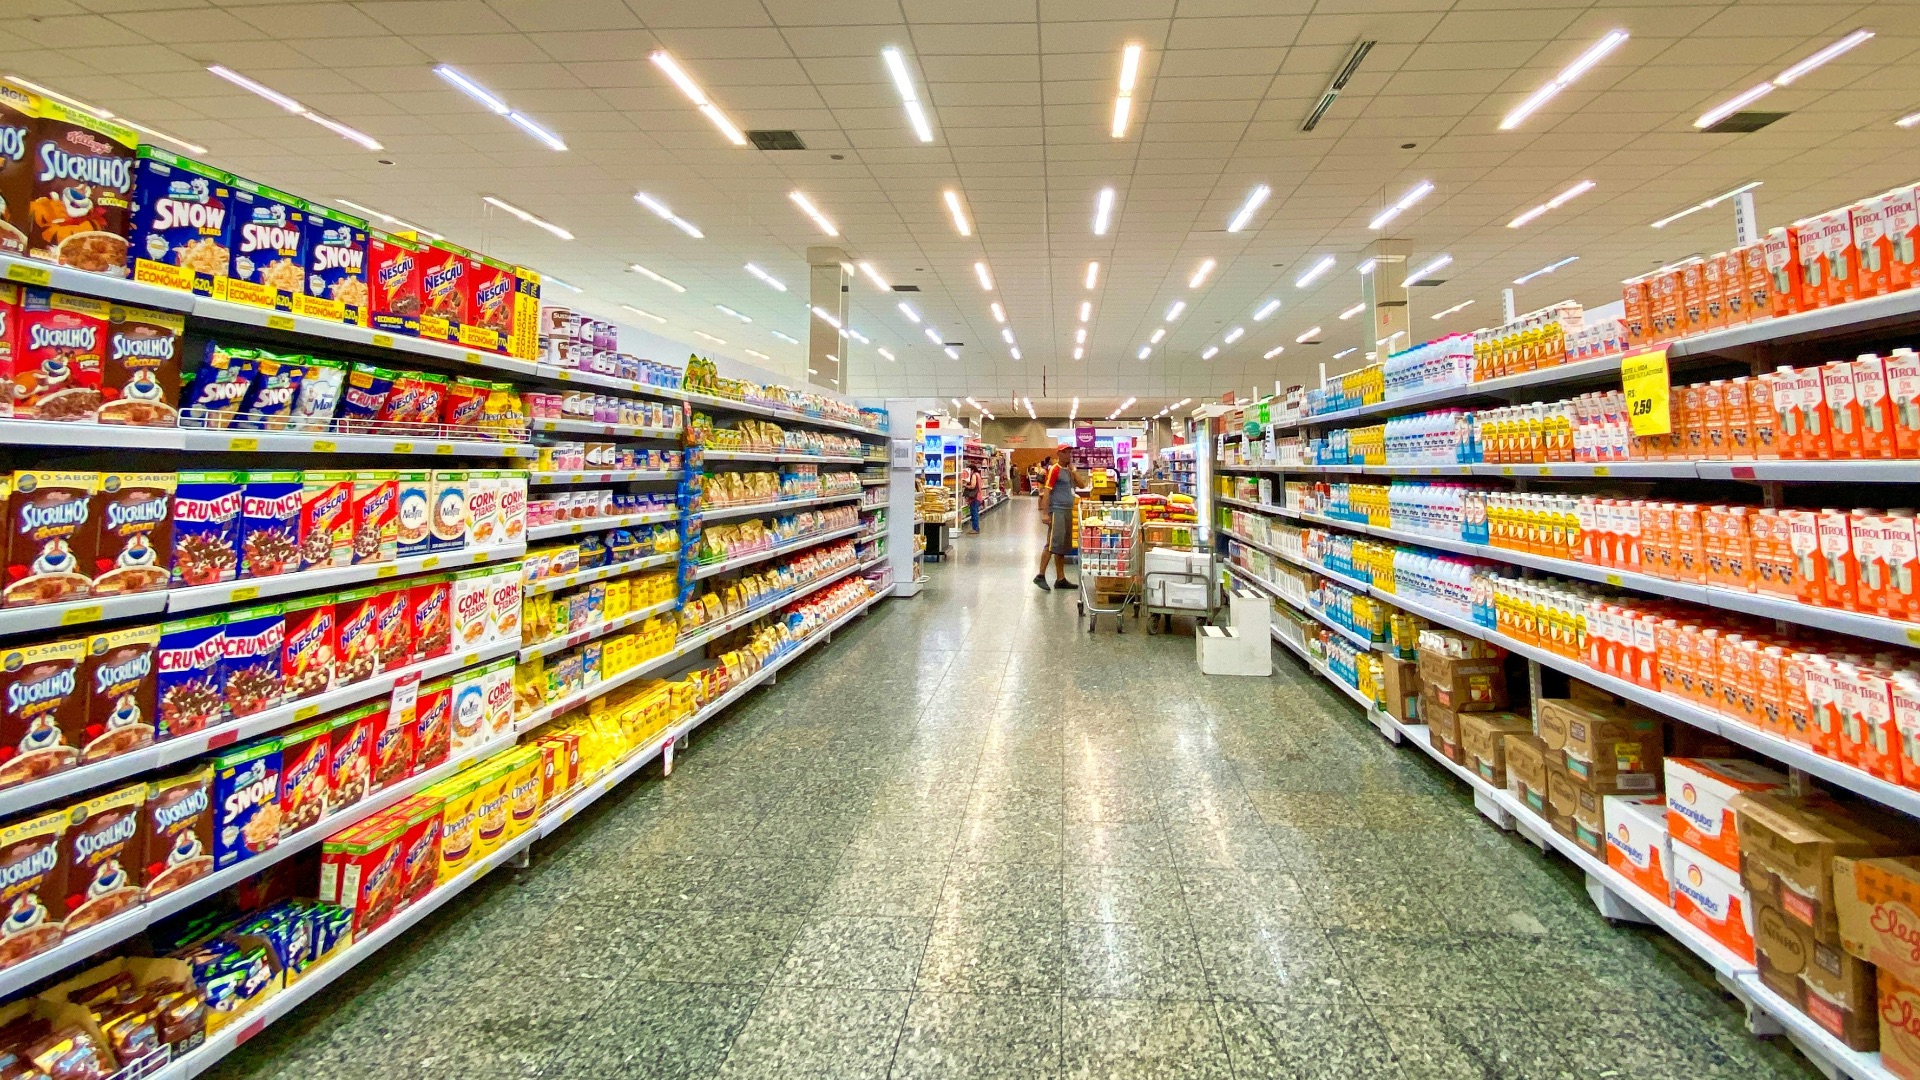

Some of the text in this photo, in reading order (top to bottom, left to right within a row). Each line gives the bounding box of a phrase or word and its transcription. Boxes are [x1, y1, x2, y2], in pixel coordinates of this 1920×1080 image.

[40, 143, 131, 194] SUCRILHOS
[153, 199, 225, 230] SNOW
[1854, 212, 1882, 227] TIROL
[1884, 202, 1915, 218] TIROL
[240, 224, 300, 252] SNOW
[1799, 231, 1822, 245] TIROL
[1823, 224, 1848, 237] TIROL
[314, 245, 364, 271] SNOW
[1765, 240, 1787, 254] TIROL
[138, 260, 180, 275] EMBALAGEM
[379, 258, 414, 284] NESCAU
[425, 262, 463, 293] NESCAU
[137, 269, 192, 291] ECONÔMICA
[477, 280, 511, 306] NESCAU
[420, 317, 441, 325] BALAGEM
[420, 322, 447, 337] CONÔMICA
[30, 324, 97, 350] SUCRILHOS
[113, 334, 175, 360] SUCRILHOS
[1796, 379, 1819, 389] TIROL
[1825, 375, 1852, 386] TIROL
[1854, 372, 1882, 383] TIROL
[1888, 367, 1919, 379] TIROL
[1773, 381, 1796, 391] TIROL
[348, 389, 387, 410] CRUNC
[174, 494, 240, 520] CRUNCH
[244, 492, 302, 516] CRUNCH
[312, 490, 347, 521] NESCAU
[363, 488, 394, 519] NESCAU
[469, 491, 495, 511] CORN
[501, 490, 523, 509] CORN
[21, 497, 90, 533] SUCRILHOS
[107, 496, 168, 530] SUCRILHOS
[1791, 523, 1814, 535] TIROL
[1820, 525, 1846, 536] TIROL
[1852, 527, 1880, 539] TIROL
[1881, 528, 1913, 541] TIROL
[458, 589, 485, 613] CORN
[493, 582, 517, 606] CORN
[415, 589, 446, 625] NESCAU
[124, 628, 159, 639] SABOR
[288, 615, 332, 661] NESCAU
[341, 605, 376, 648] NESCAU
[27, 642, 85, 657] O SABOR
[223, 623, 286, 656] CRUNCH
[159, 634, 226, 670] CRUNCH
[97, 650, 152, 694] SUCRILHOS
[1805, 670, 1830, 685] TIROL
[8, 666, 76, 714] SUCRILHOS
[487, 679, 510, 705] CORN
[1833, 679, 1858, 694] TIROL
[1859, 687, 1886, 703] TIROL
[418, 695, 449, 737] NESCAU
[332, 725, 367, 776] NESCAU
[285, 743, 327, 795] NESCAU
[104, 786, 145, 804] SABOR
[223, 773, 278, 824] SNOW
[512, 777, 540, 799] Cheerios
[155, 786, 208, 834] SUCRILHOS
[1669, 797, 1713, 828] Piracanjuba
[20, 814, 67, 833] SABOR
[442, 812, 476, 838] Cheerios
[76, 811, 137, 865] SUCRILHOS
[1607, 832, 1643, 861] Piracanjuba
